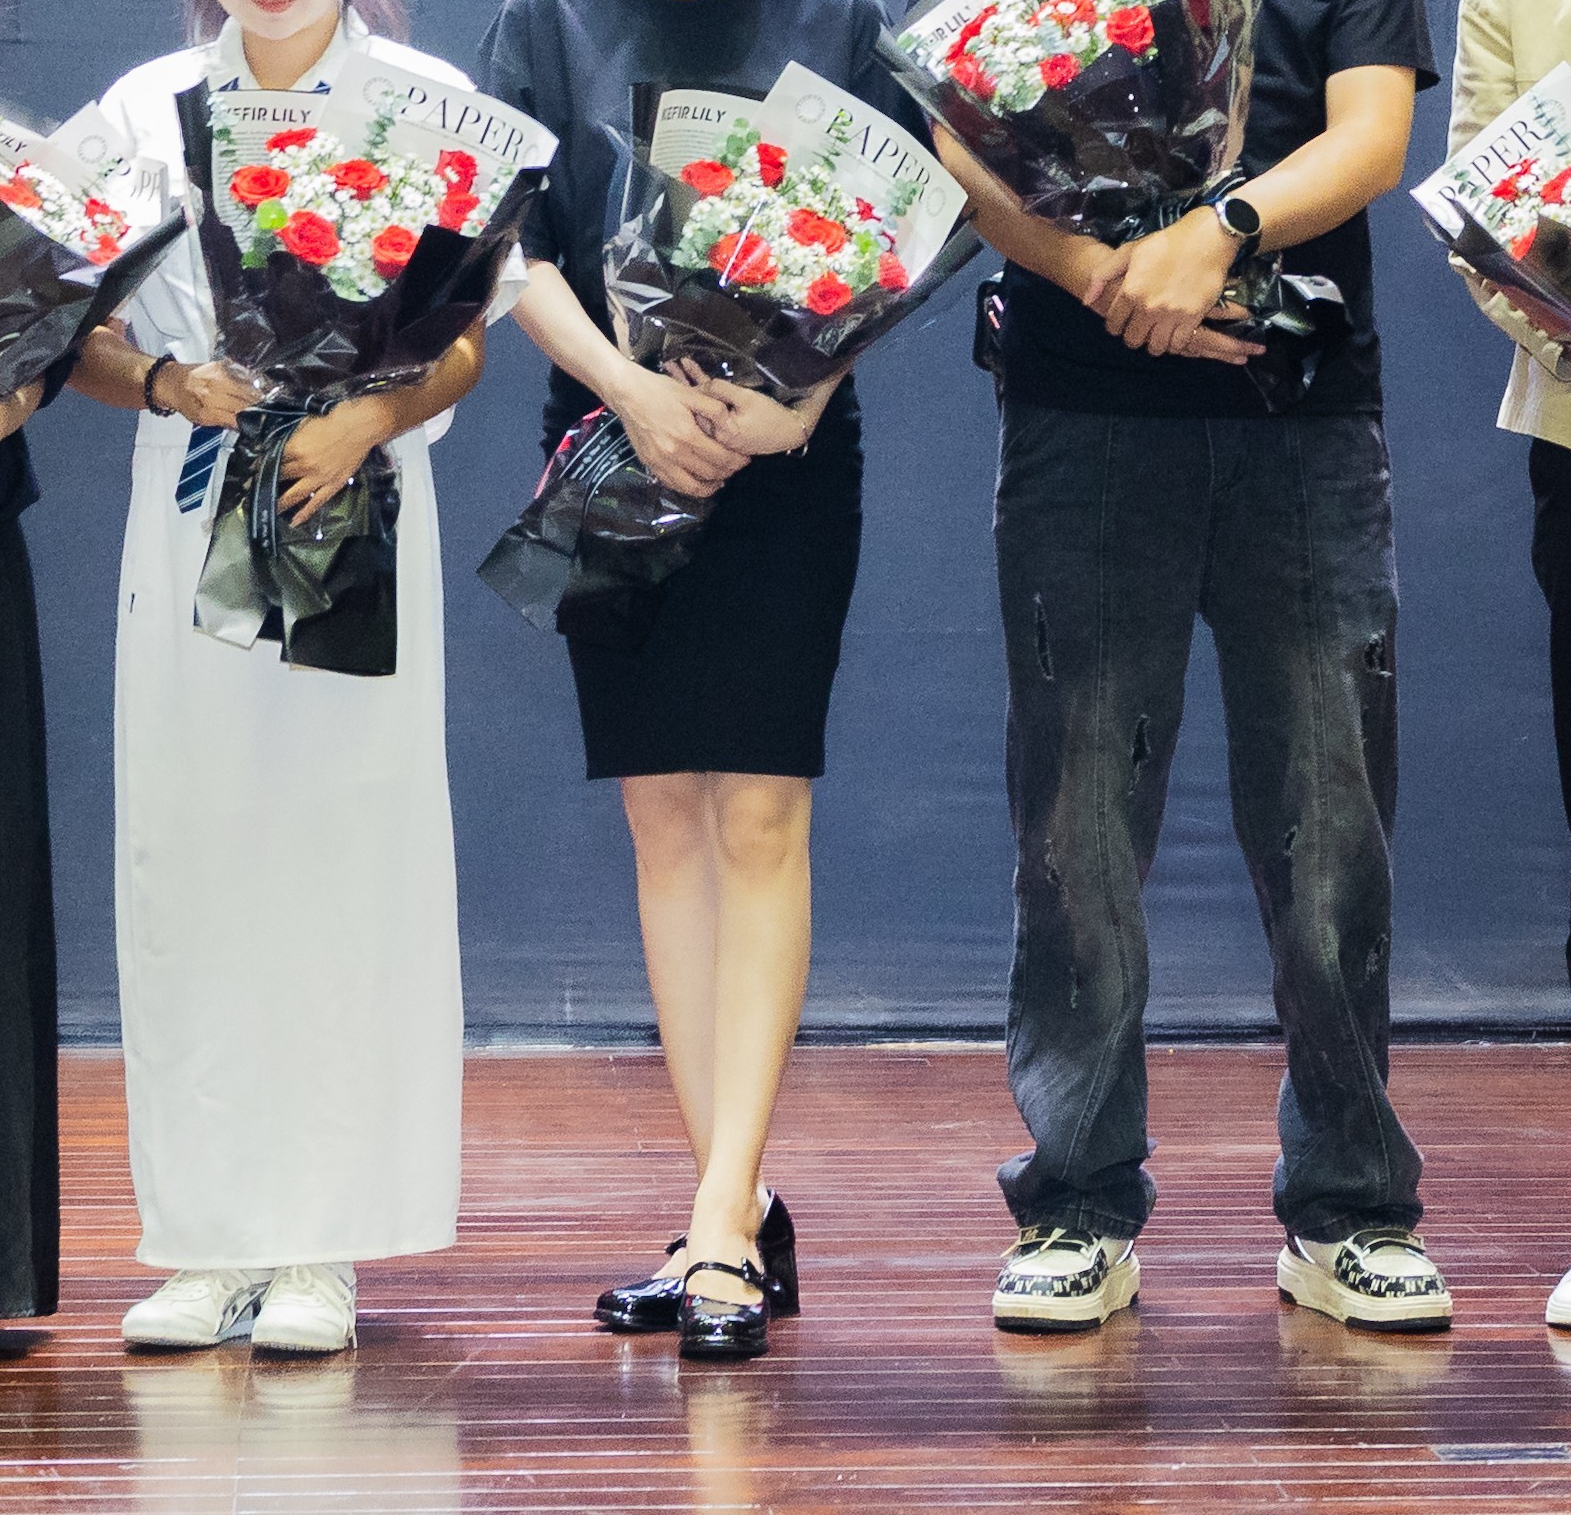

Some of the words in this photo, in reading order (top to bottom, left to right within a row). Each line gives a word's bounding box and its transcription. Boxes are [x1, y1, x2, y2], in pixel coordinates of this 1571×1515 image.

[272, 108, 312, 124] LILY
[400, 86, 525, 164] PAPER
[691, 106, 727, 123] LILY
[1437, 119, 1545, 202] PPER
